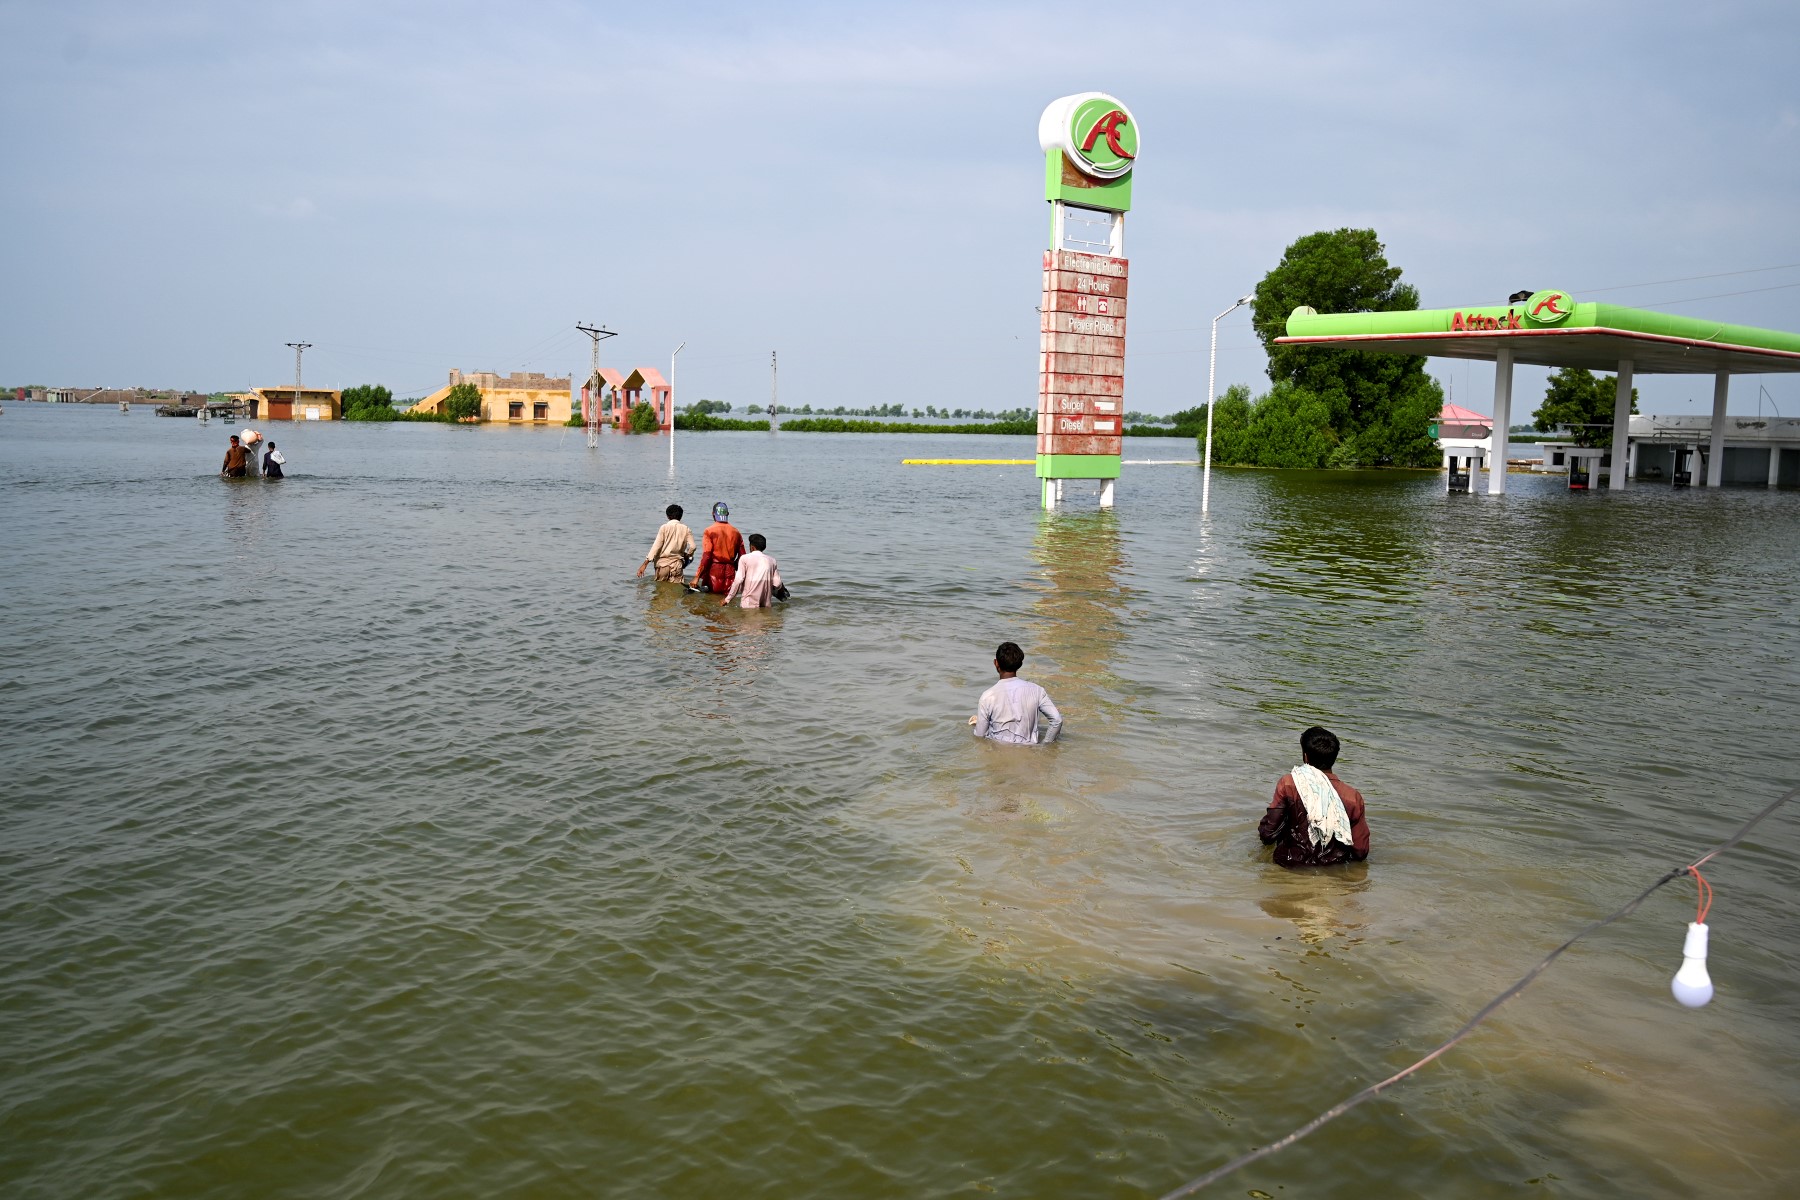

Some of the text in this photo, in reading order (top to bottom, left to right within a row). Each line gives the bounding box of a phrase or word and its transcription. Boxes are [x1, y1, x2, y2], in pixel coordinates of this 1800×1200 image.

[1065, 256, 1123, 273] Electronic Pump
[1077, 278, 1109, 292] 24 Hours
[1069, 317, 1114, 332] Prayer Place
[1451, 309, 1522, 332] Attock
[1062, 399, 1084, 412] Super
[1061, 419, 1084, 431] Diesel
